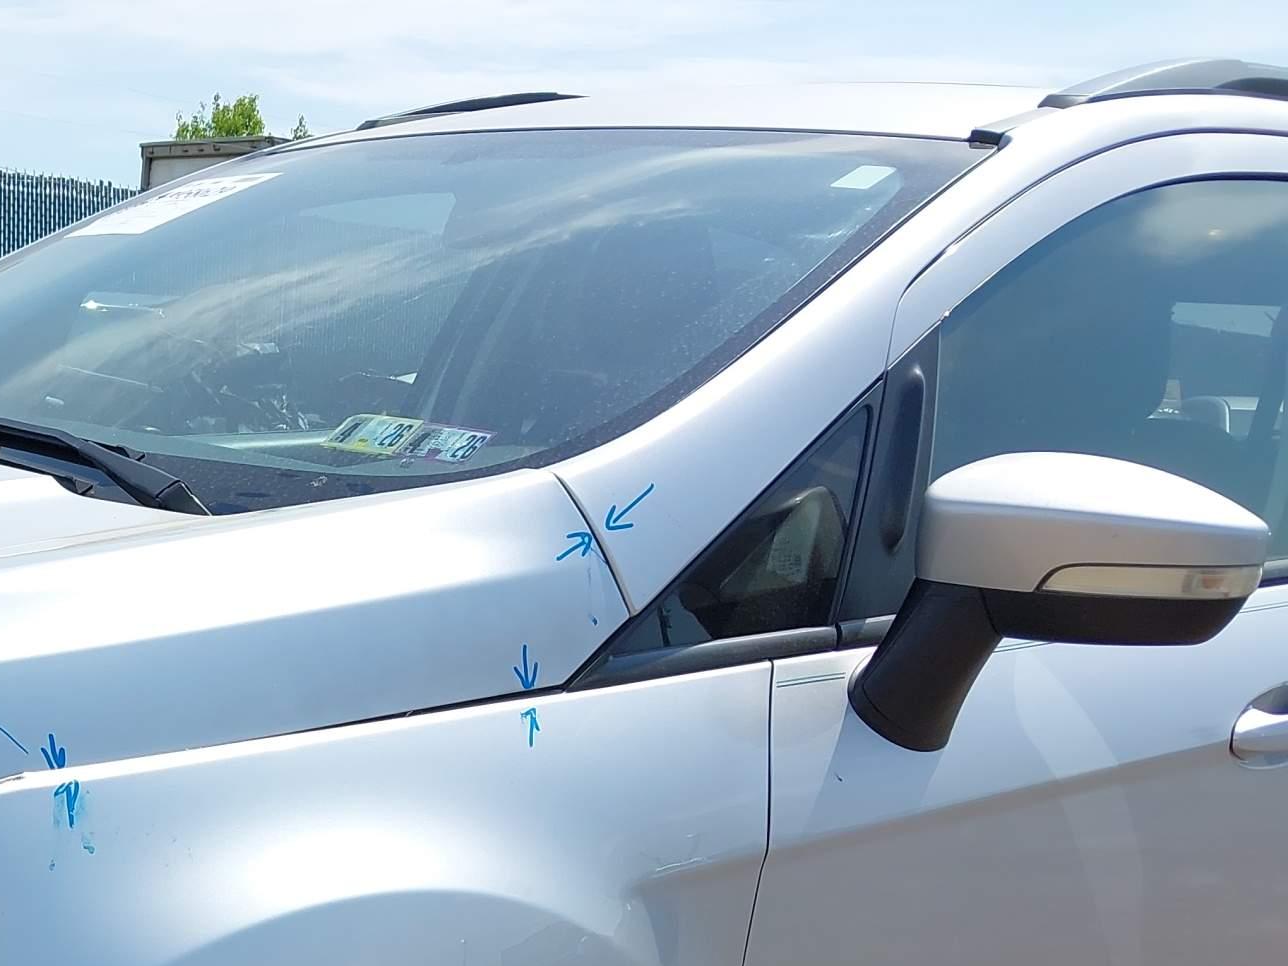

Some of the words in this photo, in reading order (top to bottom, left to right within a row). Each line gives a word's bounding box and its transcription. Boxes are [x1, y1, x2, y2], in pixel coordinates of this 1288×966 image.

[335, 422, 361, 443] 4
[377, 423, 413, 448] 26
[404, 432, 431, 454] 4
[449, 434, 488, 459] 26
